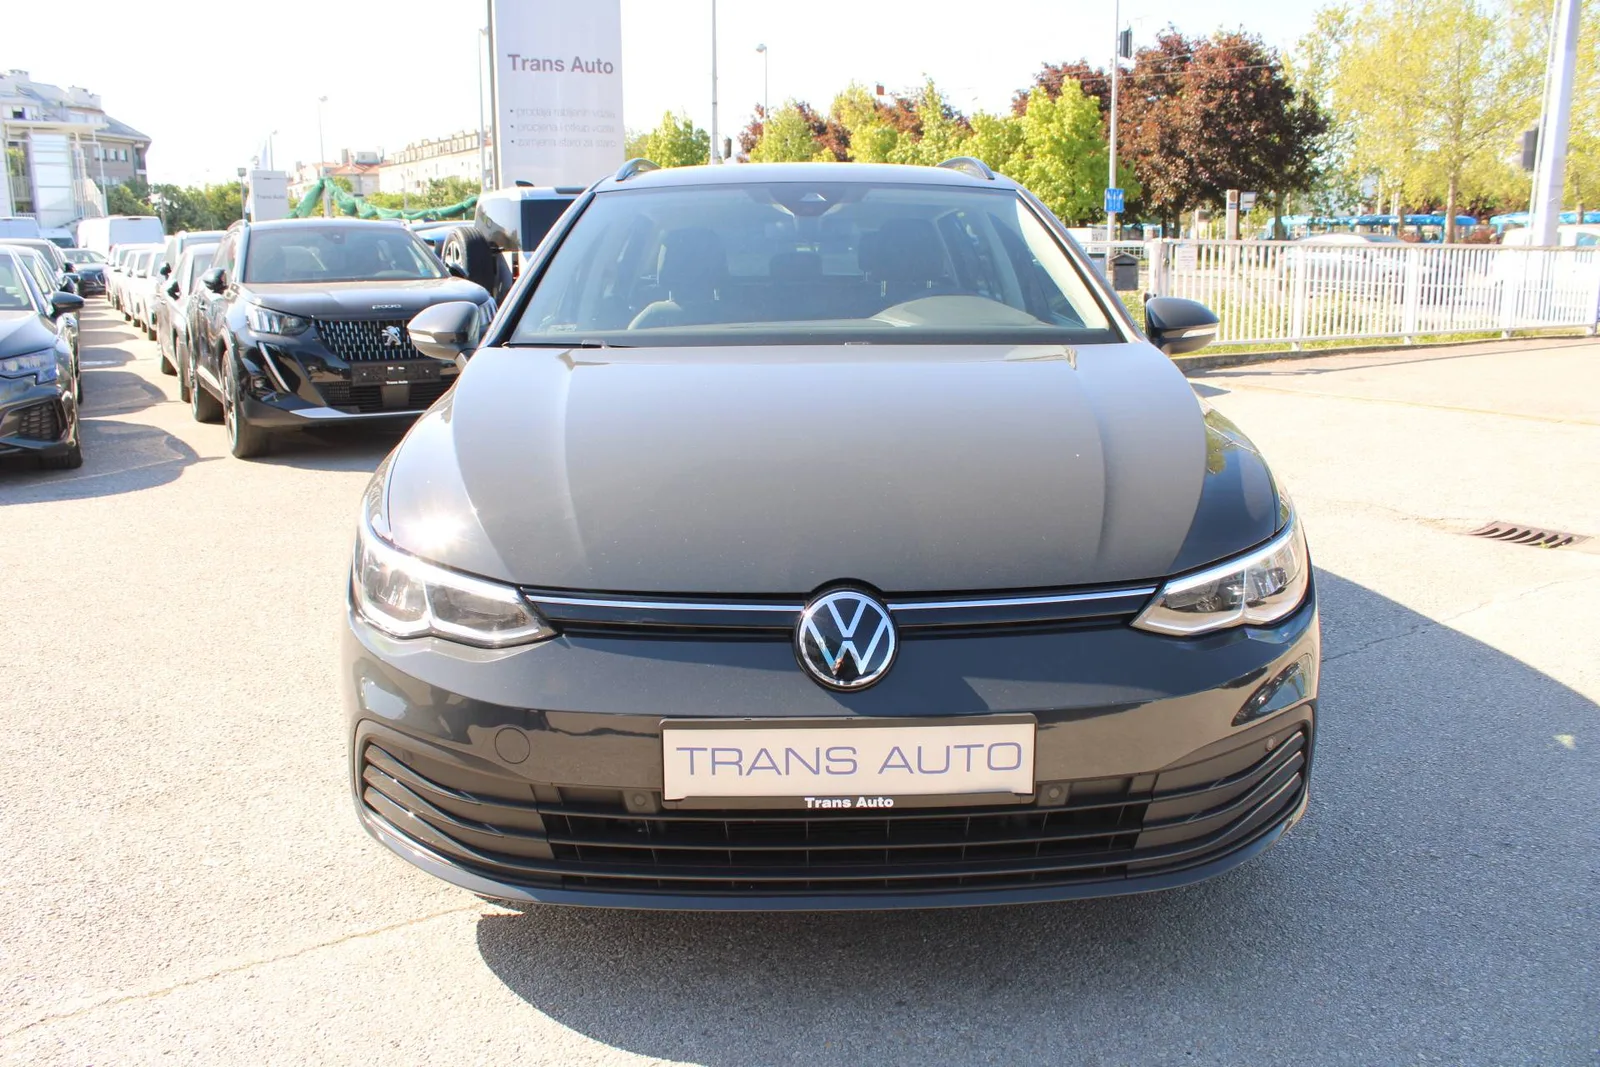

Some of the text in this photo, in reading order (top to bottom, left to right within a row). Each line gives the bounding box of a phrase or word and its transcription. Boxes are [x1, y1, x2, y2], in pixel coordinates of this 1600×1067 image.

[507, 54, 614, 75] Trans Auto
[676, 742, 1022, 777] TRANS AUTO
[804, 796, 894, 808] Trans Auto
